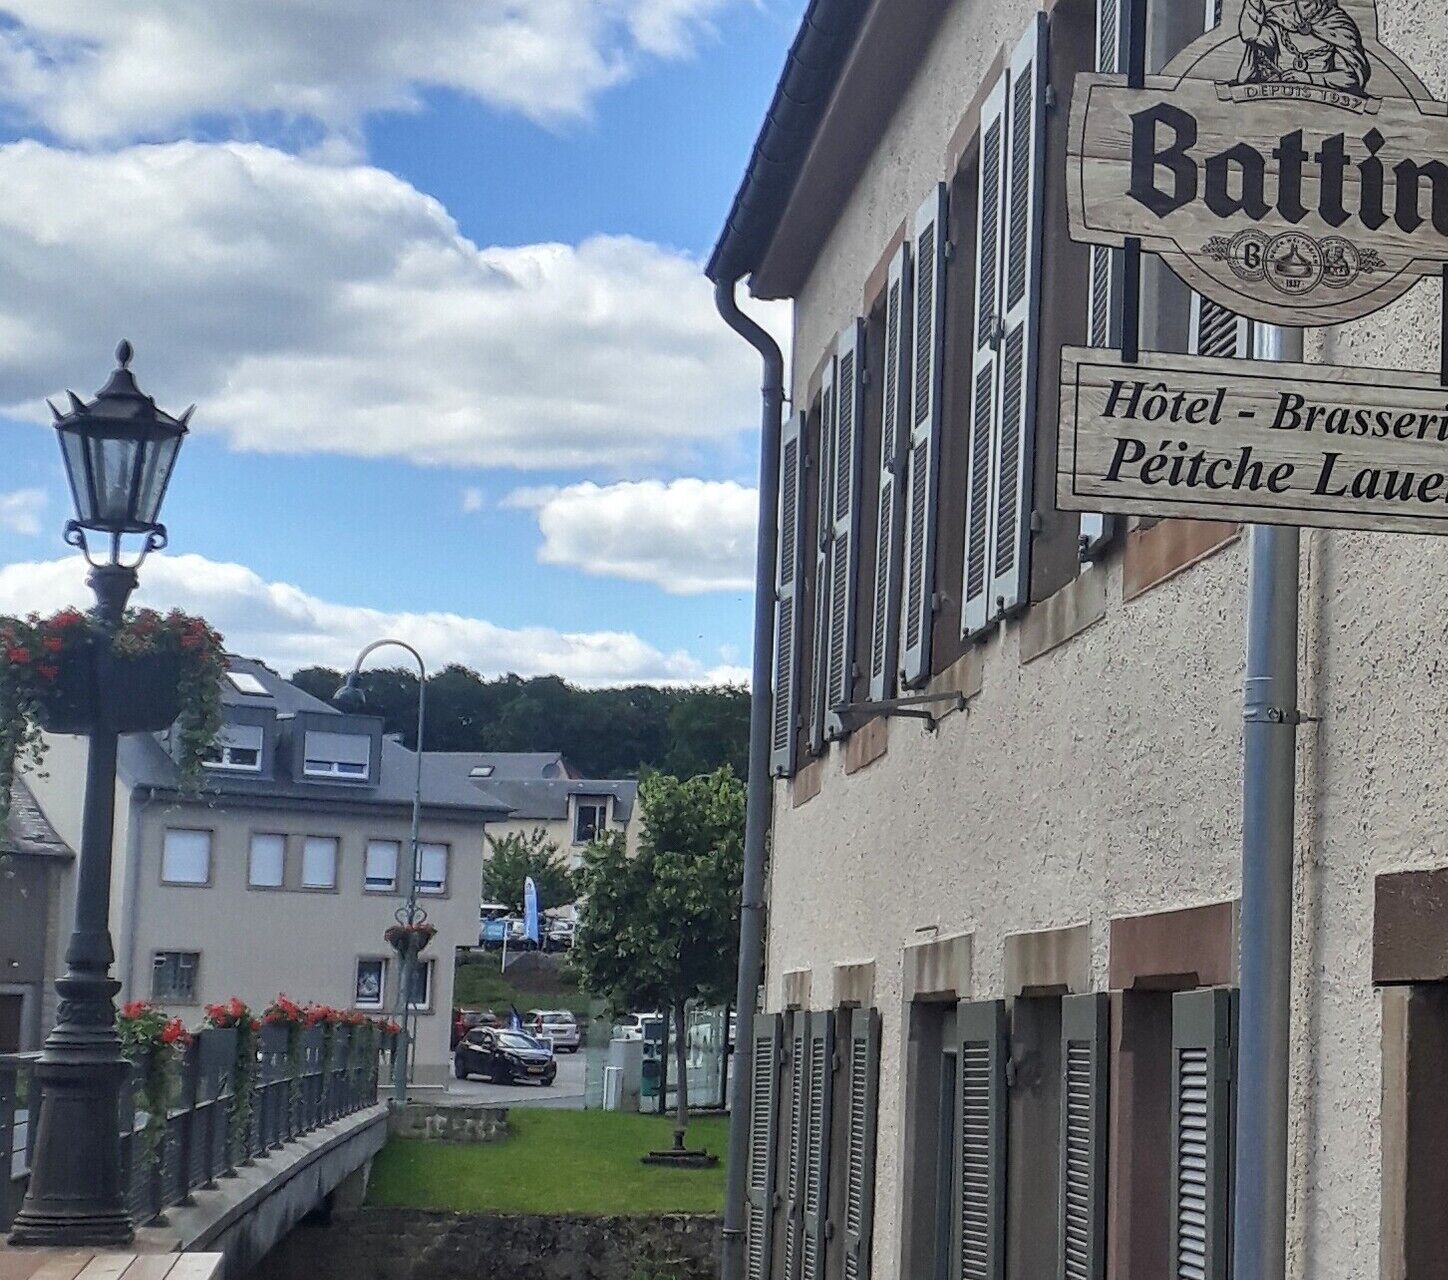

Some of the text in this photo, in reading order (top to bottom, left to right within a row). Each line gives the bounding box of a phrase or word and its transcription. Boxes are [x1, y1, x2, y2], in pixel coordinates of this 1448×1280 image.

[1244, 84, 1364, 109] DEPUIS 1937
[1100, 379, 1227, 425] Hôtel
[1101, 437, 1295, 494] Péitche
